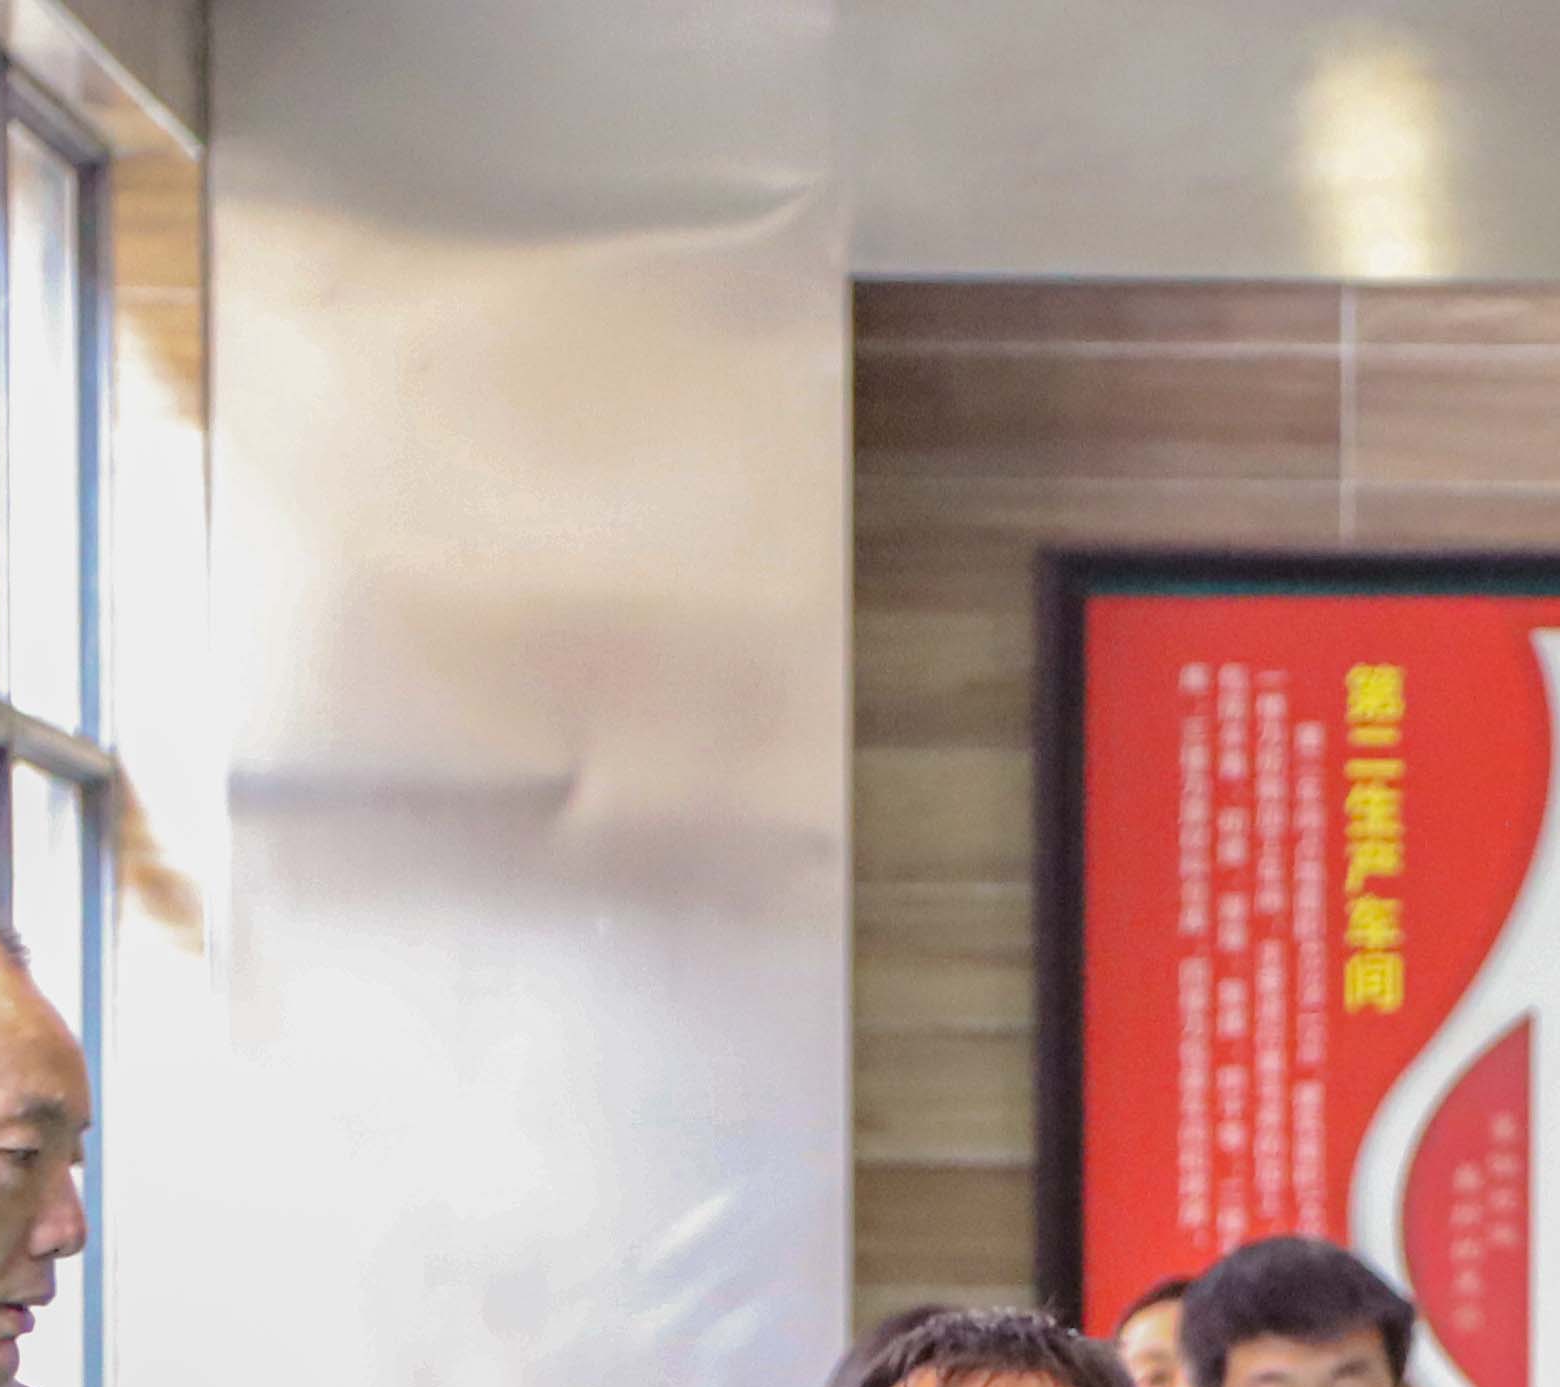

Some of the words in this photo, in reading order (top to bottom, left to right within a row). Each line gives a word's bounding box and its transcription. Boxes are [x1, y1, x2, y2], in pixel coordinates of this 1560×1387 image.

[1345, 662, 1406, 1015] 第二生产车间
